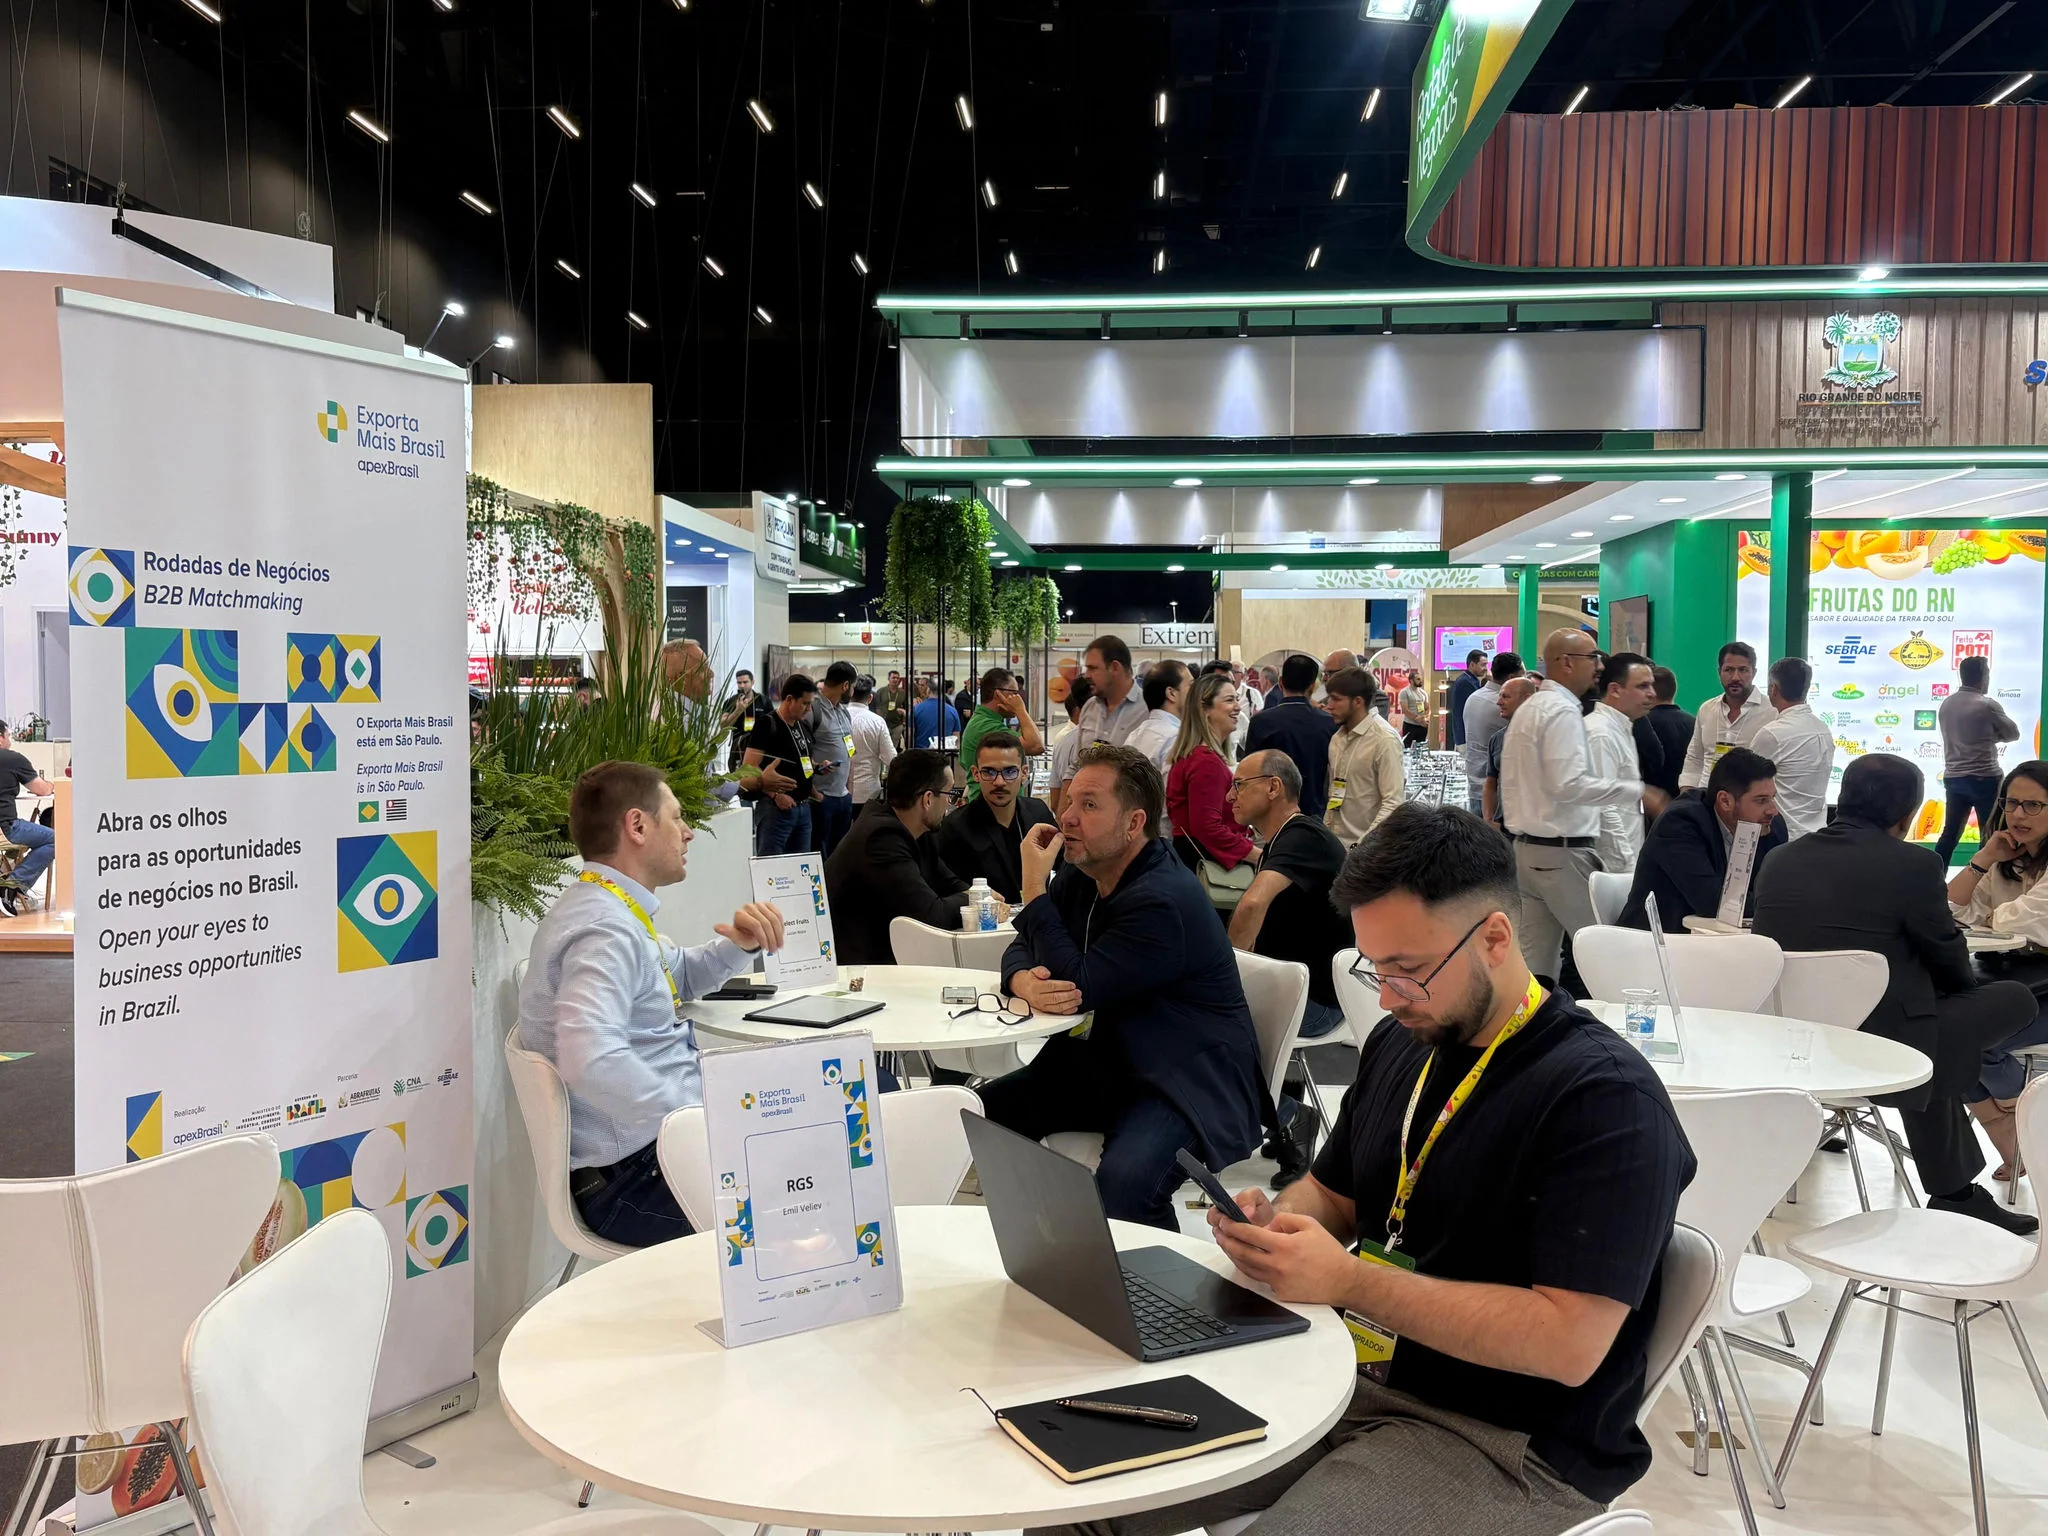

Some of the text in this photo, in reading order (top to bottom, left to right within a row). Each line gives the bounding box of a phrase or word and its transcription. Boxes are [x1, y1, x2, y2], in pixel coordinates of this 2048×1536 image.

[2025, 359, 2048, 384] S
[1799, 391, 1922, 402] RIO GRANDE DO NORTE
[357, 405, 419, 433] Exporta
[357, 429, 446, 459] Mais Brasil
[357, 459, 420, 479] apexBrasil
[144, 551, 330, 584] Rodadas de Negócios
[144, 584, 303, 616] B2B Matchmaking
[1808, 588, 1955, 612] FRUTAS DO RN
[1956, 635, 1973, 643] Feito
[1825, 645, 1877, 655] SEBRAE
[1955, 644, 1989, 656] POTI
[357, 716, 453, 732] O Exporta Mais Brasil
[357, 735, 442, 747] está em São Paulo.
[357, 760, 443, 777] Exporta Mais Brasil
[357, 780, 425, 794] is in São Paulo.
[97, 807, 228, 833] Abra os olhos
[98, 837, 302, 876] para as oportunidades
[98, 870, 298, 910] de negócios no Brasil.
[99, 913, 269, 954] Open your eyes to
[99, 943, 302, 990] business opportunities
[99, 995, 181, 1026] in Brazil.
[406, 1077, 421, 1086] CNA
[437, 1072, 459, 1082] SEBRAE
[350, 1087, 380, 1100] ABRAFRUTAS
[759, 1087, 791, 1101] Exporta
[760, 1093, 806, 1109] Mais Brasil
[174, 1106, 206, 1118] Realização:
[761, 1107, 793, 1118] apexBrasil
[173, 1124, 223, 1145] apexBrasil
[787, 1176, 814, 1193] RGS
[783, 1201, 822, 1216] Emil Veliev
[1351, 1331, 1385, 1355] MPRADOR
[441, 1401, 455, 1411] FULL
